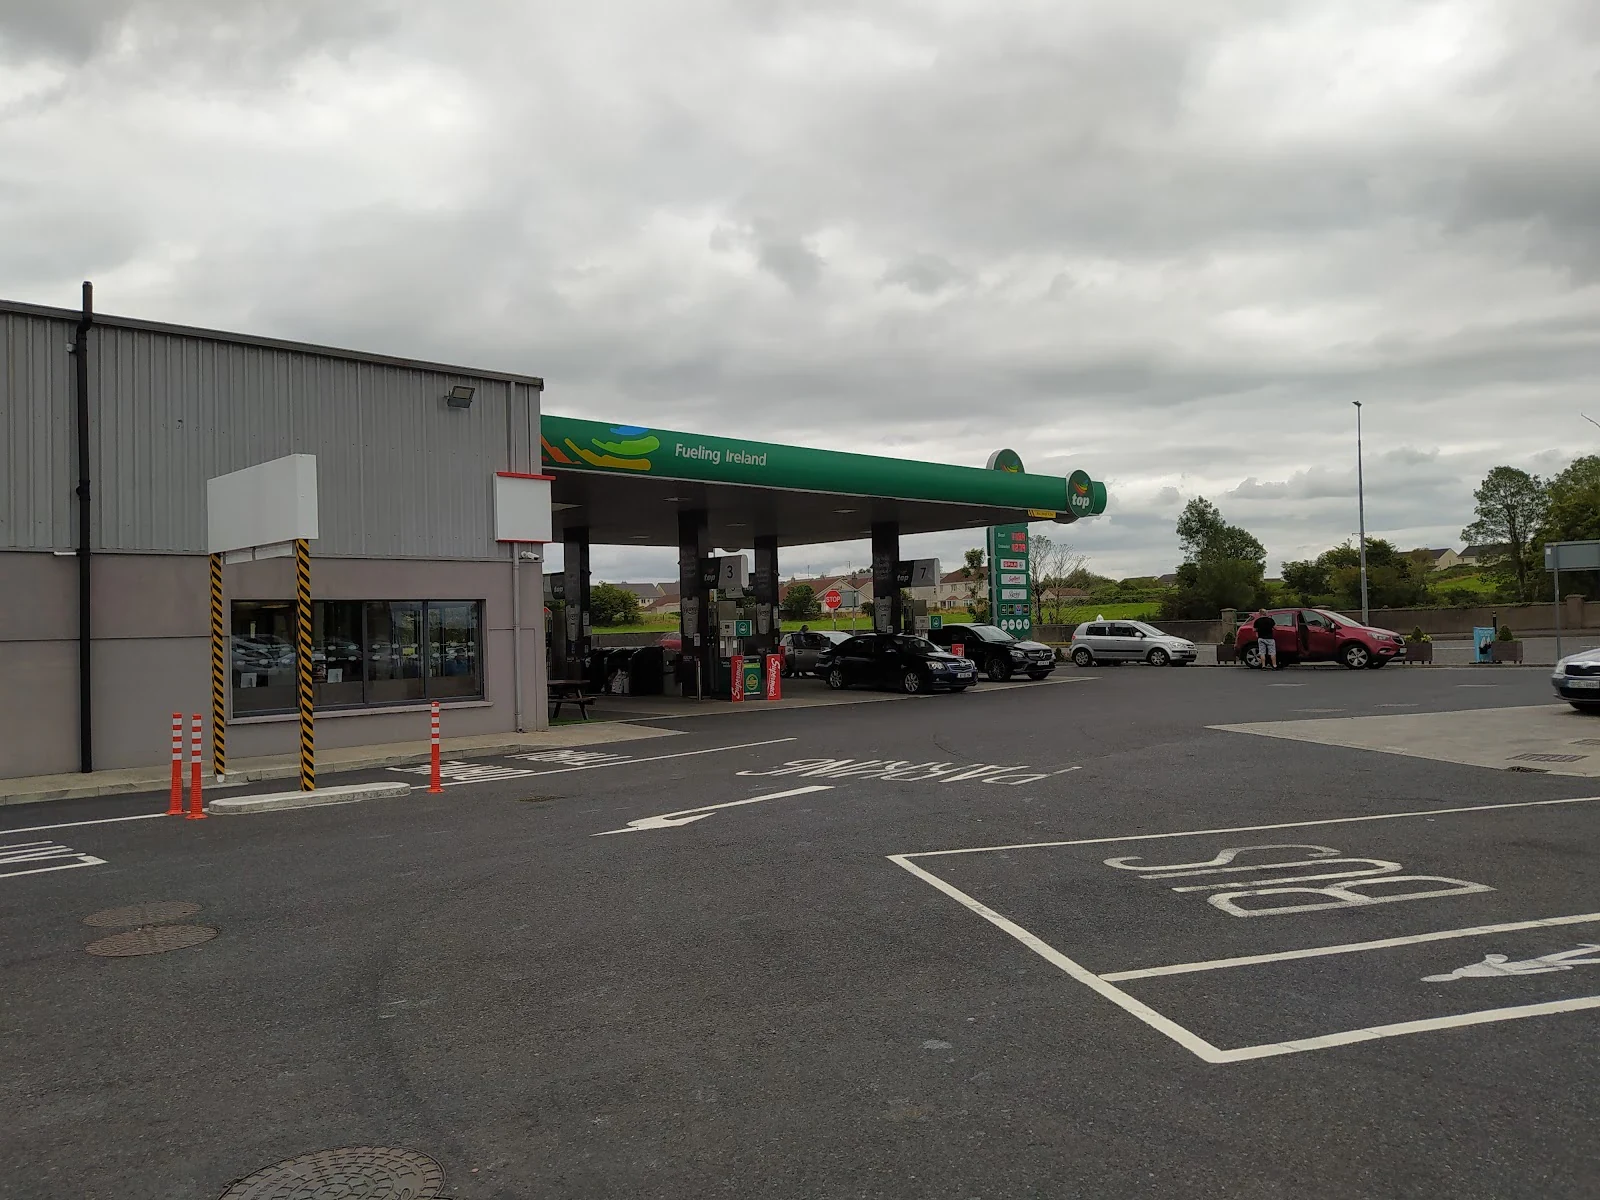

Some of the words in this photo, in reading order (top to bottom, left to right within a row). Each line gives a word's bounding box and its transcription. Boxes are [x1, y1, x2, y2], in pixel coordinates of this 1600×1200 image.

[675, 443, 721, 464] Fueling
[726, 449, 766, 466] Ireland
[1072, 493, 1090, 509] top
[704, 573, 716, 583] top
[726, 565, 734, 579] 3
[896, 574, 909, 583] top
[920, 567, 927, 579] 7
[826, 595, 841, 603] STOP
[735, 758, 1083, 786] PARKING
[1102, 844, 1500, 918] BUS
